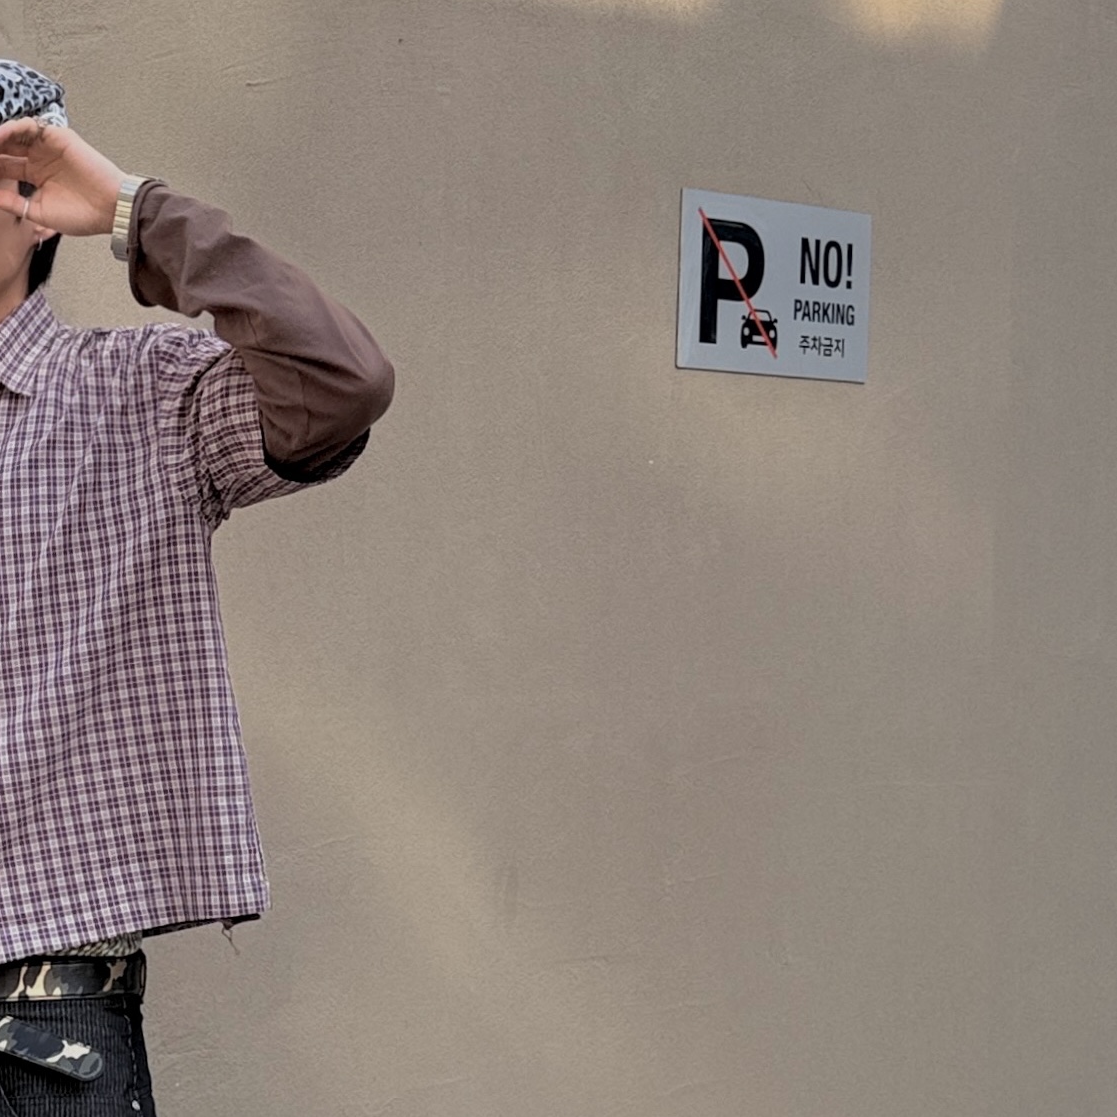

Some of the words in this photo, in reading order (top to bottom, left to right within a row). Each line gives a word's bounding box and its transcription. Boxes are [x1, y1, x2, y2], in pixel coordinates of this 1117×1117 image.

[799, 237, 853, 290] NO!
[793, 299, 855, 326] PARKING
[799, 335, 845, 358] 주차금지
